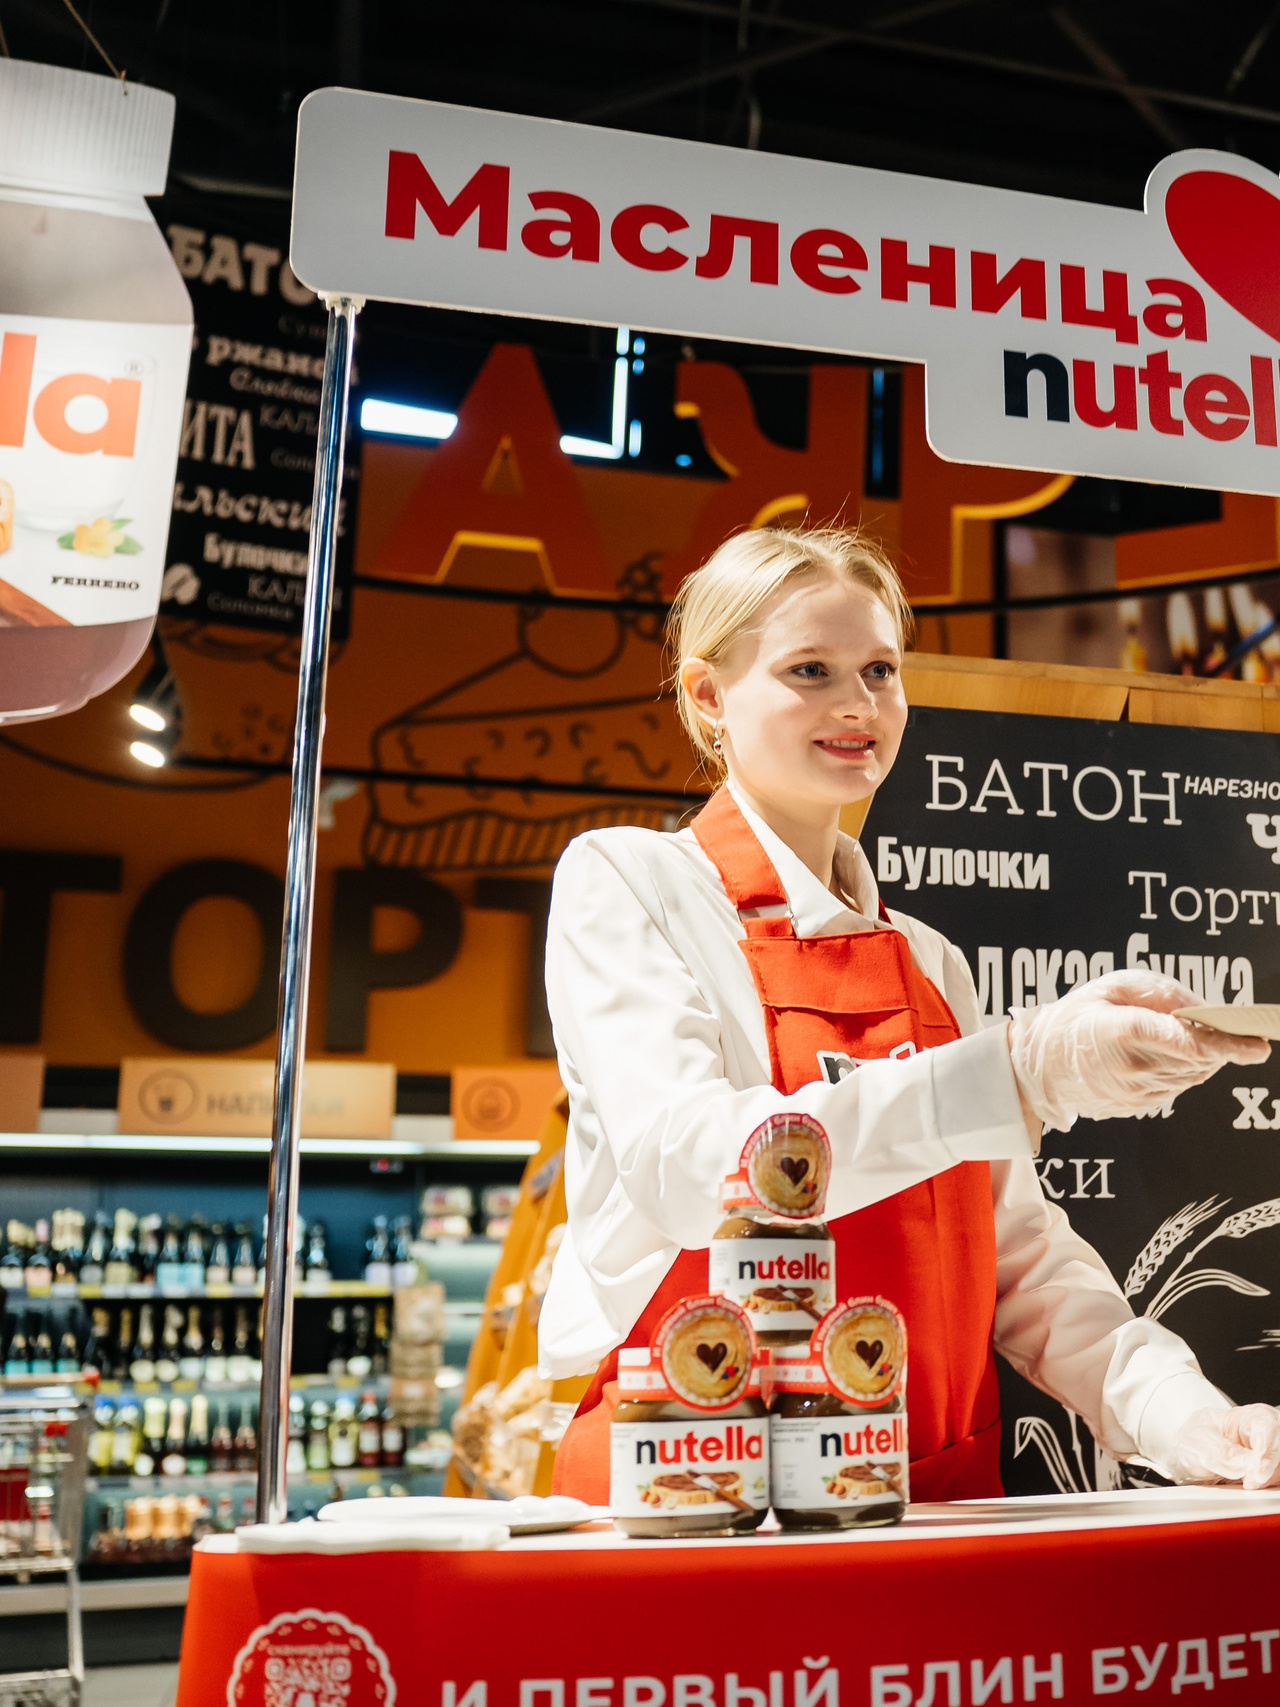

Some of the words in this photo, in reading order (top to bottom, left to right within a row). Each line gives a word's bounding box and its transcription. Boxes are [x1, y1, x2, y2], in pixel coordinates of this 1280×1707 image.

[384, 149, 1208, 346] Масленица
[51, 575, 140, 591] FERRERO
[925, 754, 1183, 826] БАТОН
[877, 835, 1050, 891] Булочки
[738, 1252, 830, 1281] nutella
[636, 1425, 763, 1465] nutella
[869, 1652, 1065, 1707] БЛИН
[1091, 1628, 1280, 1695] БУДЕТ
